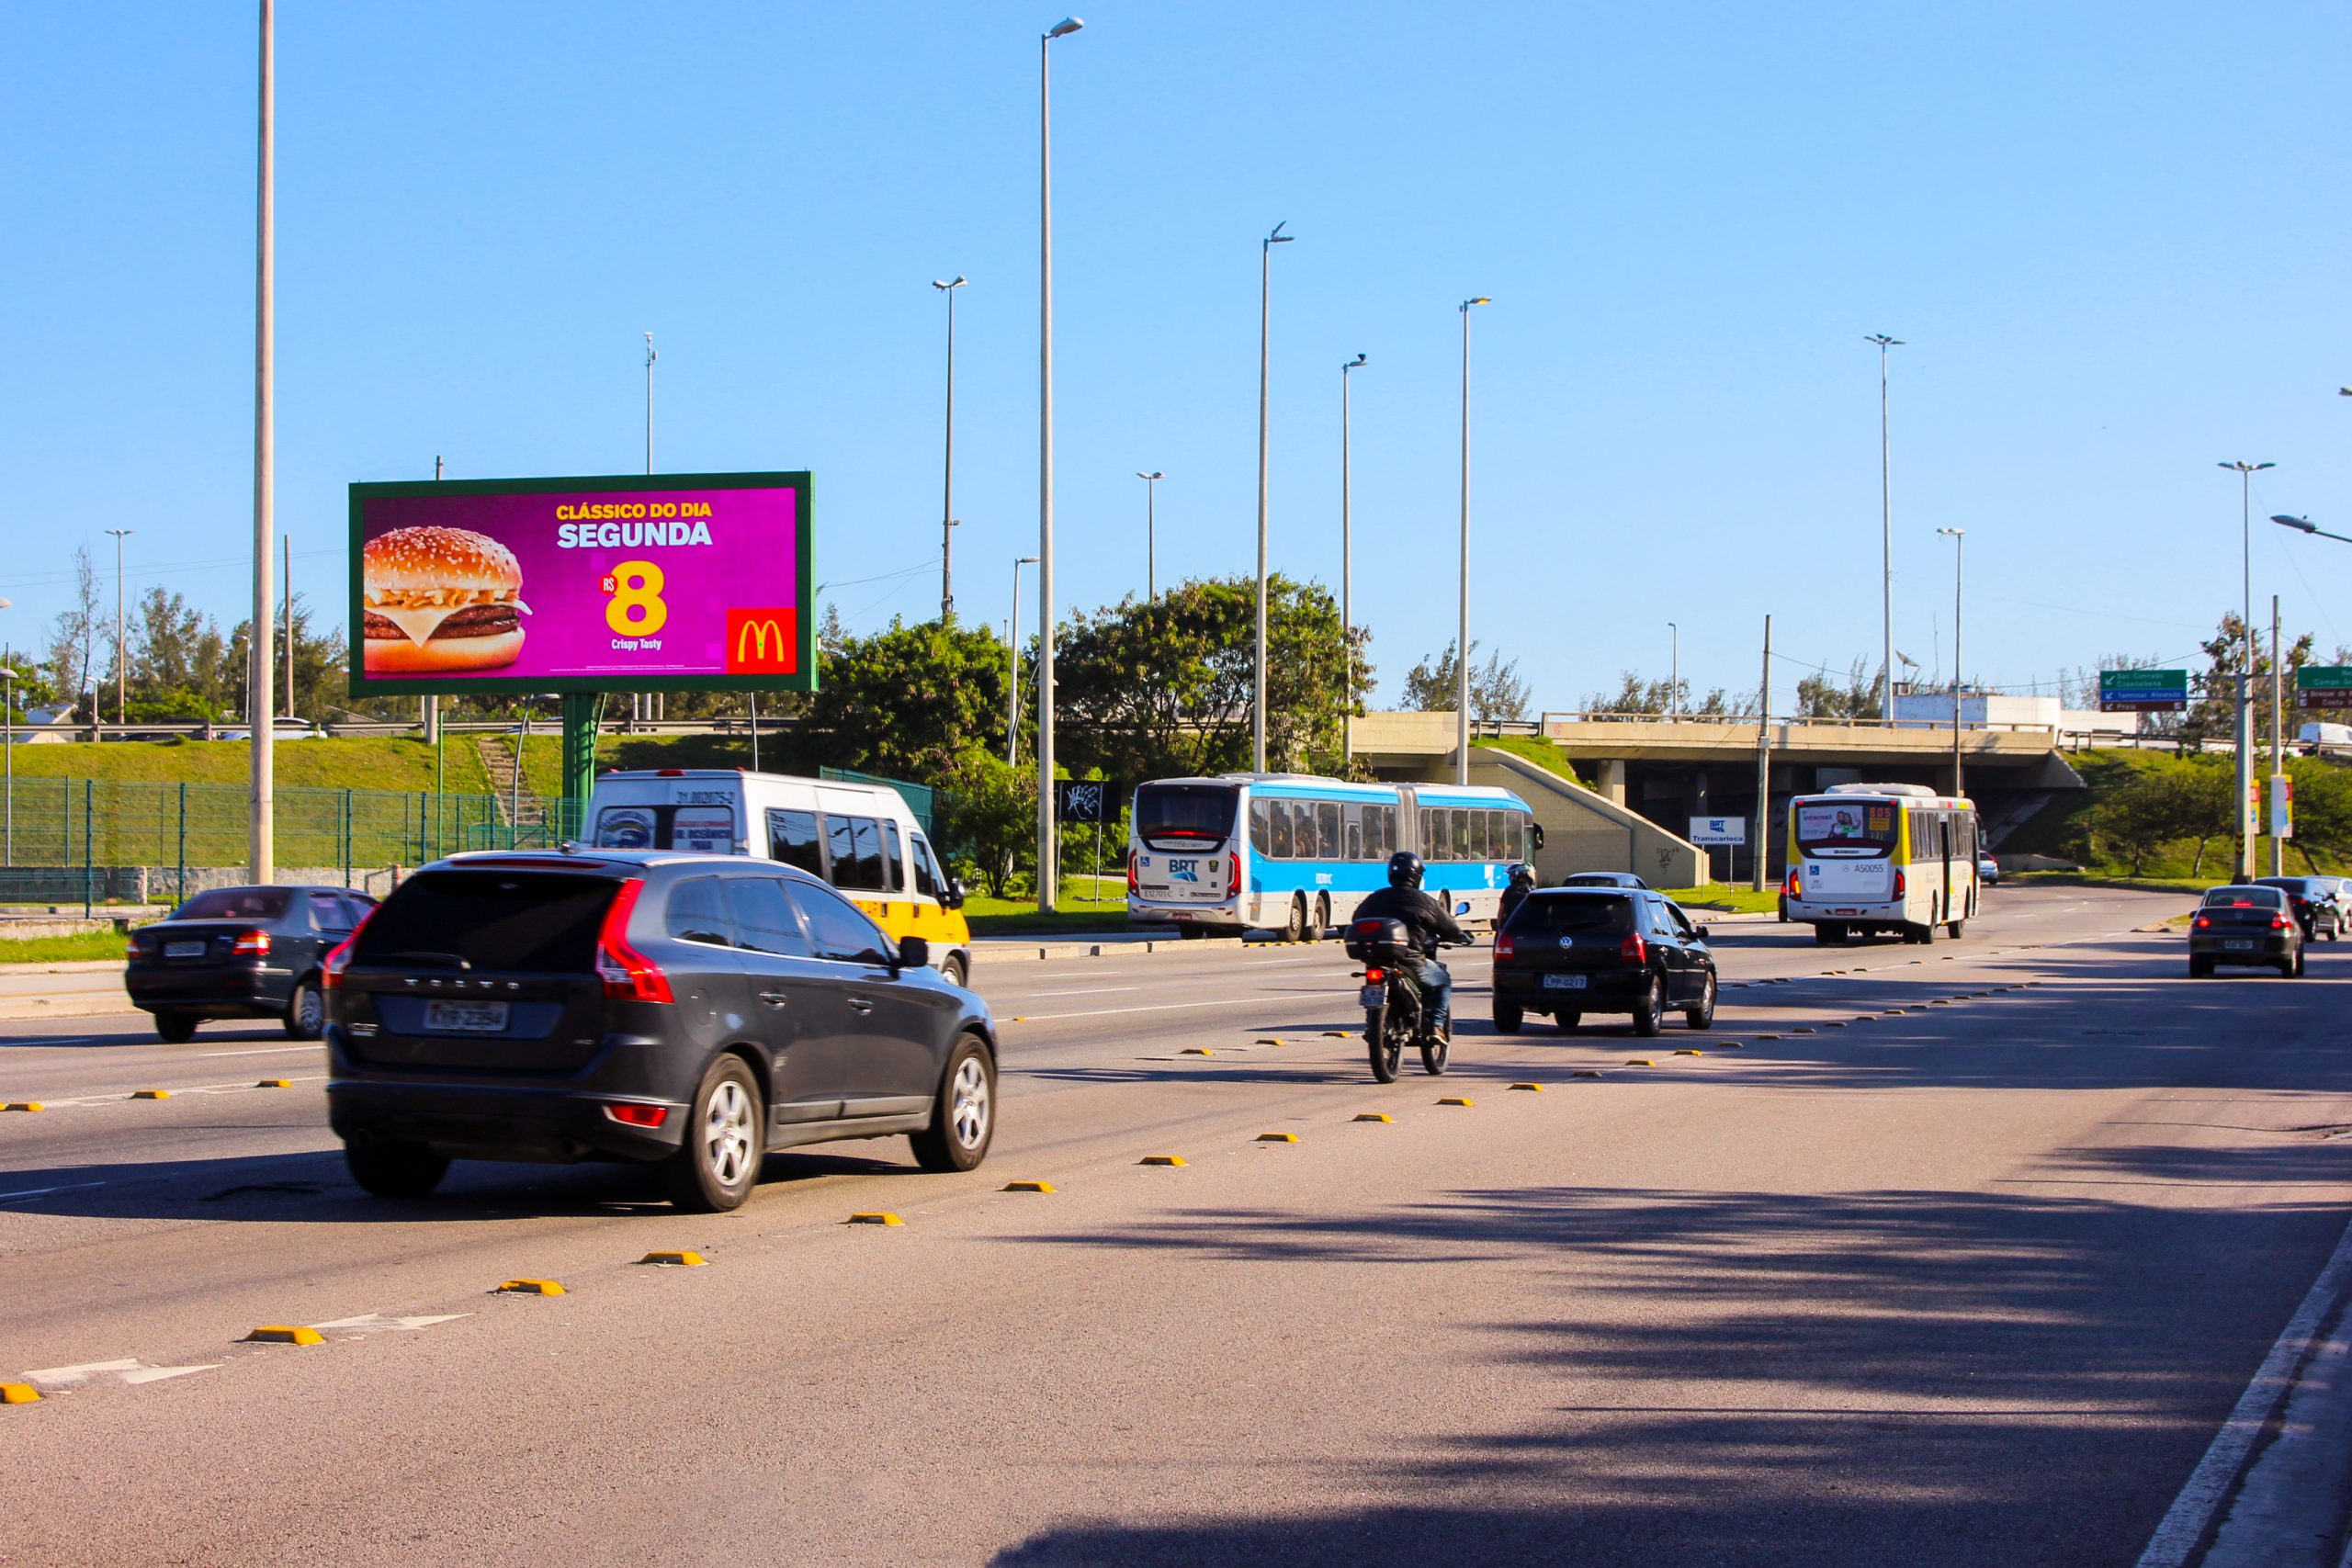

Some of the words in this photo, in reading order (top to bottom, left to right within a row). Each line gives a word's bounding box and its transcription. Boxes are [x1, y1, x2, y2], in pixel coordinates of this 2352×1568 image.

[556, 502, 646, 520] CLÁSSICO
[650, 503, 677, 518] DO
[681, 502, 713, 517] DIA
[557, 521, 713, 548] SEGUNDA
[605, 559, 667, 637] 8
[611, 638, 639, 651] Crispy
[639, 637, 662, 650] Tasty
[1710, 819, 1724, 828] BRT
[1169, 859, 1199, 874] BRT
[1855, 864, 1883, 874] A50055
